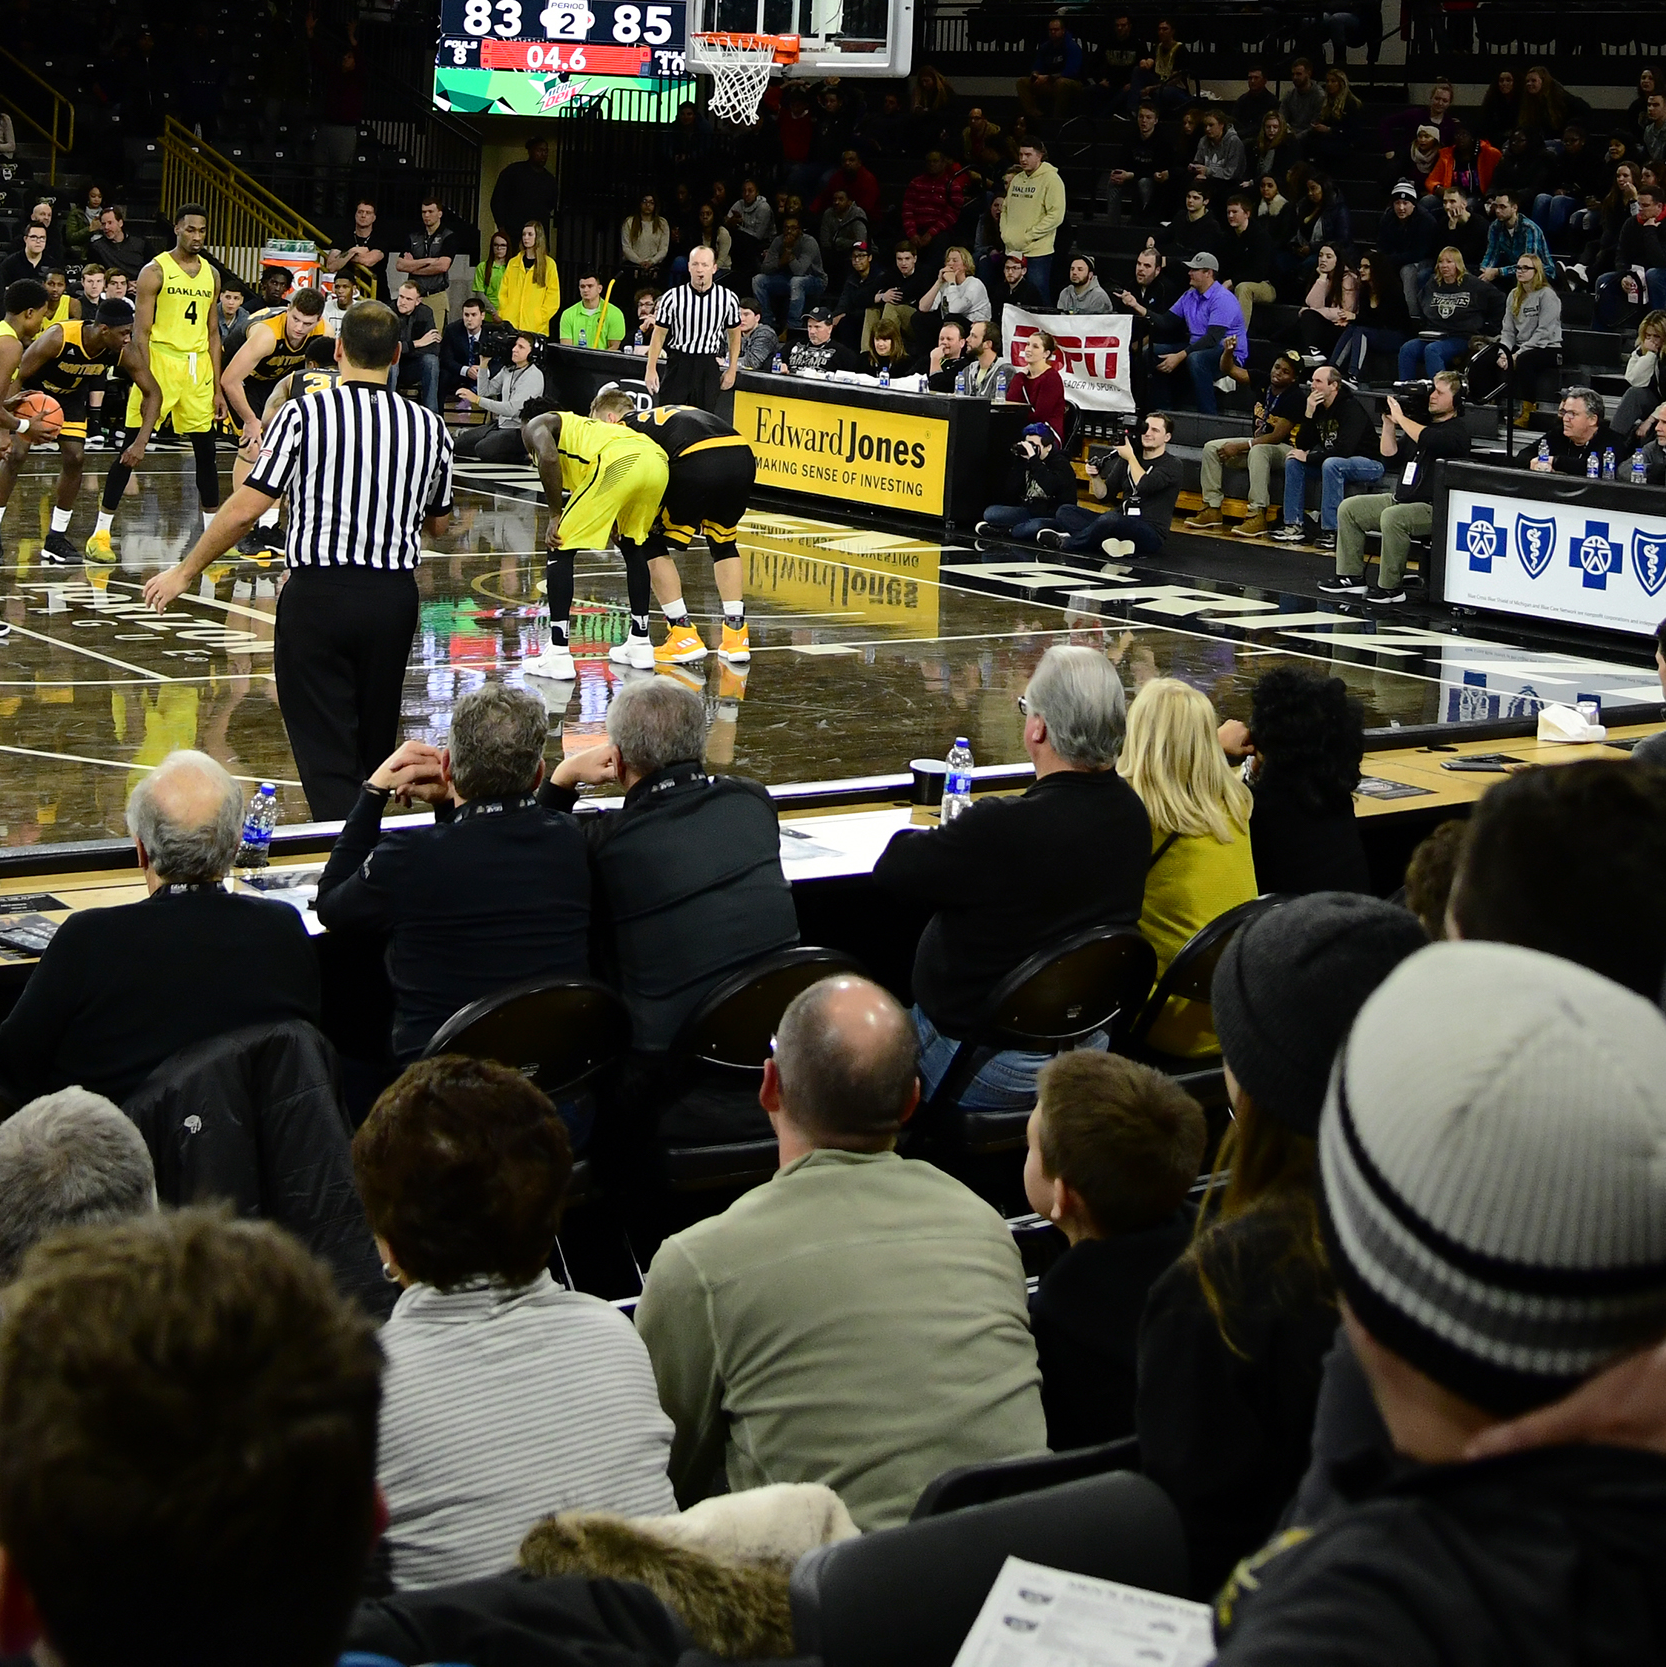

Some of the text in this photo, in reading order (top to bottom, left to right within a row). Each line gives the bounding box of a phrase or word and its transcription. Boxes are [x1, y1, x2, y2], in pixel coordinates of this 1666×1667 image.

[551, 2, 584, 10] PERIOD
[560, 13, 574, 34] 2
[612, 5, 672, 44] 85
[444, 40, 478, 49] FOULS
[453, 48, 466, 65] 8
[527, 46, 586, 70] 04.6
[167, 286, 212, 298] OAKLAND
[185, 301, 198, 325] 4
[755, 456, 923, 497] MAKING SENSE OF INVESTING
